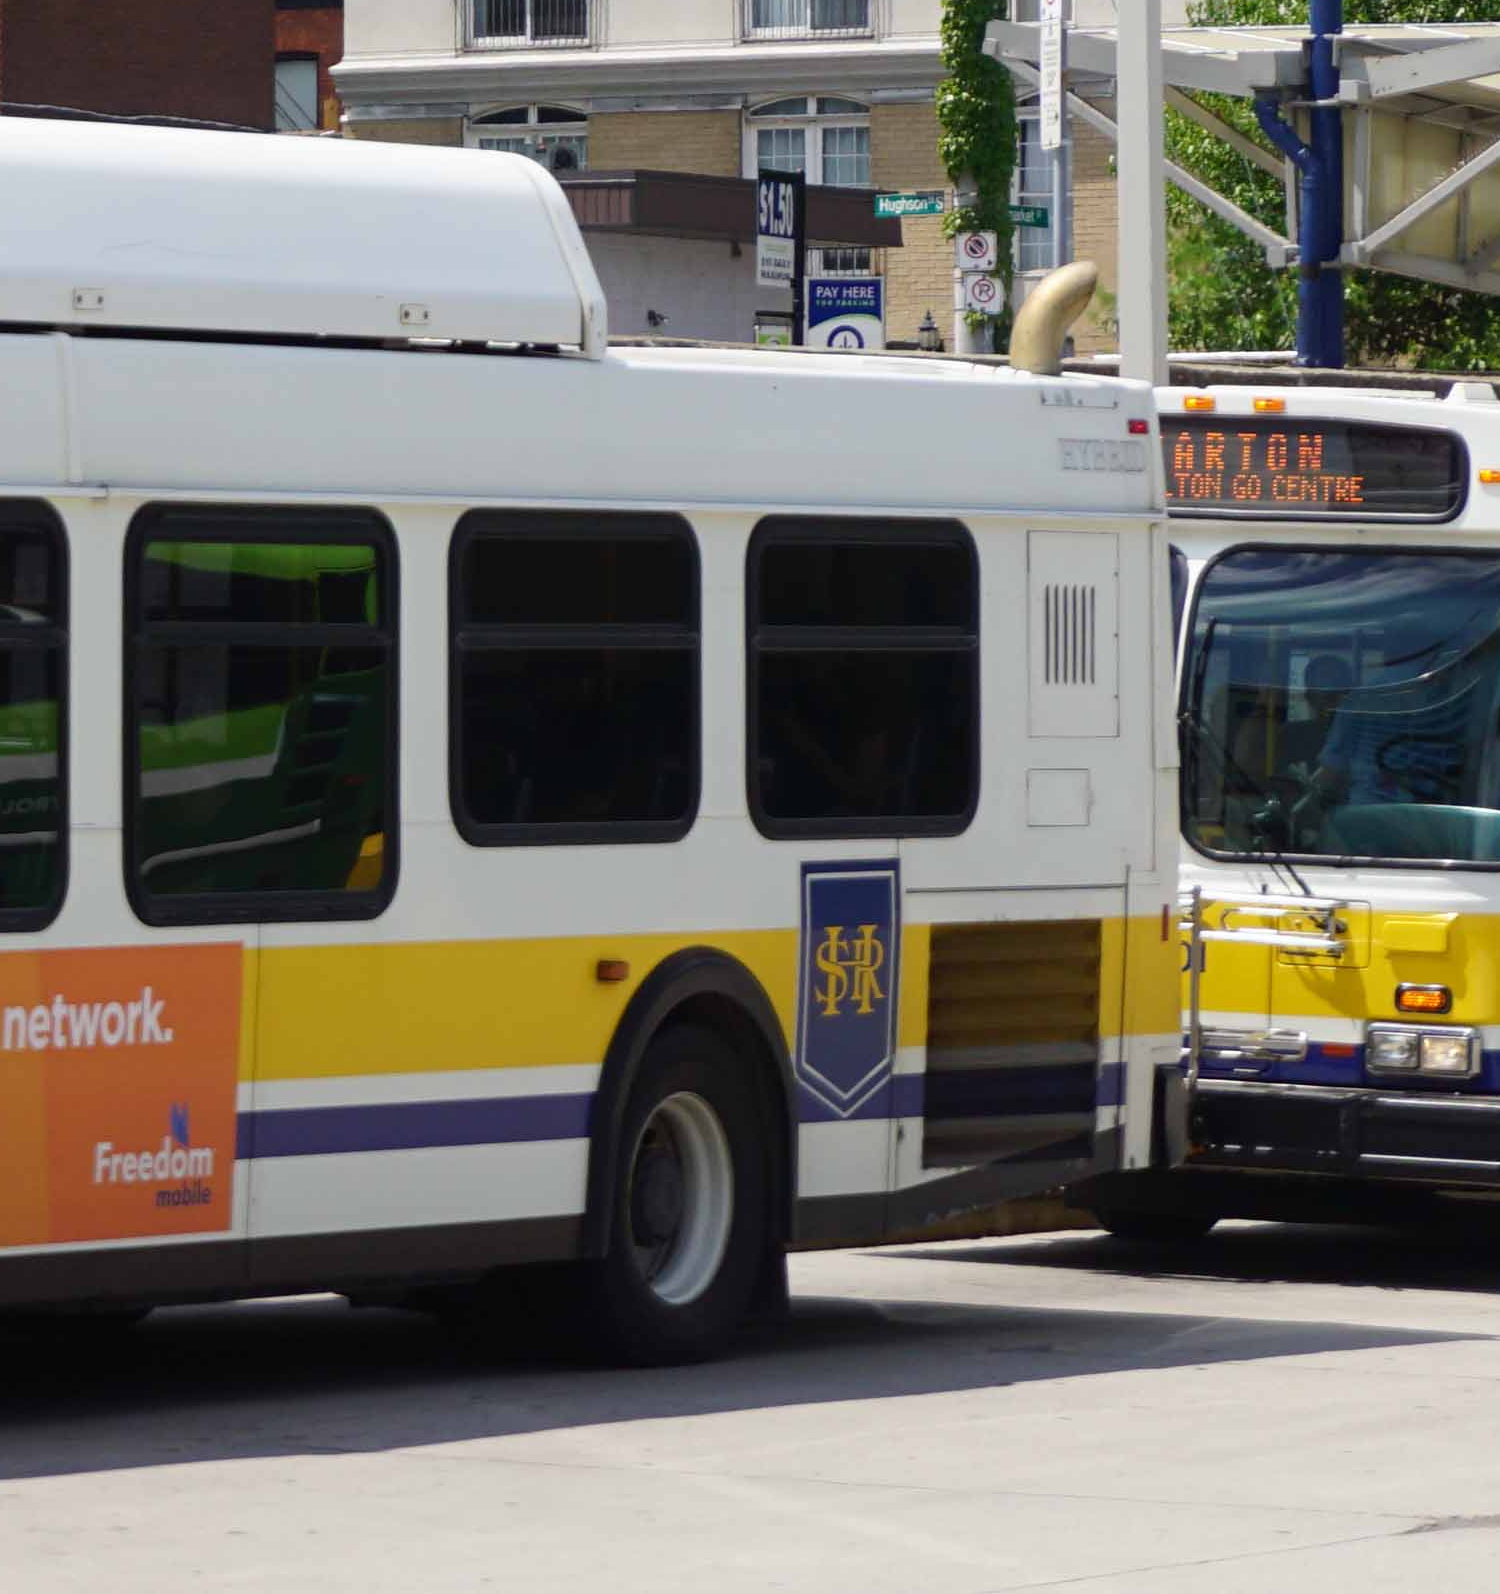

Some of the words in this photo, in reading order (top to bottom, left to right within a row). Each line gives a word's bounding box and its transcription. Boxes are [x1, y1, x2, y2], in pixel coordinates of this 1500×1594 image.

[759, 181, 794, 237] $1.50
[879, 196, 928, 214] Hughson
[816, 286, 839, 298] PAY
[842, 286, 875, 298] HERE
[1160, 431, 1323, 471] ARTON
[1232, 473, 1262, 500] GO
[1271, 475, 1365, 503] CENTRE
[2, 987, 173, 1050] network.
[93, 1135, 213, 1184] Freedom
[155, 1178, 212, 1207] mobile
